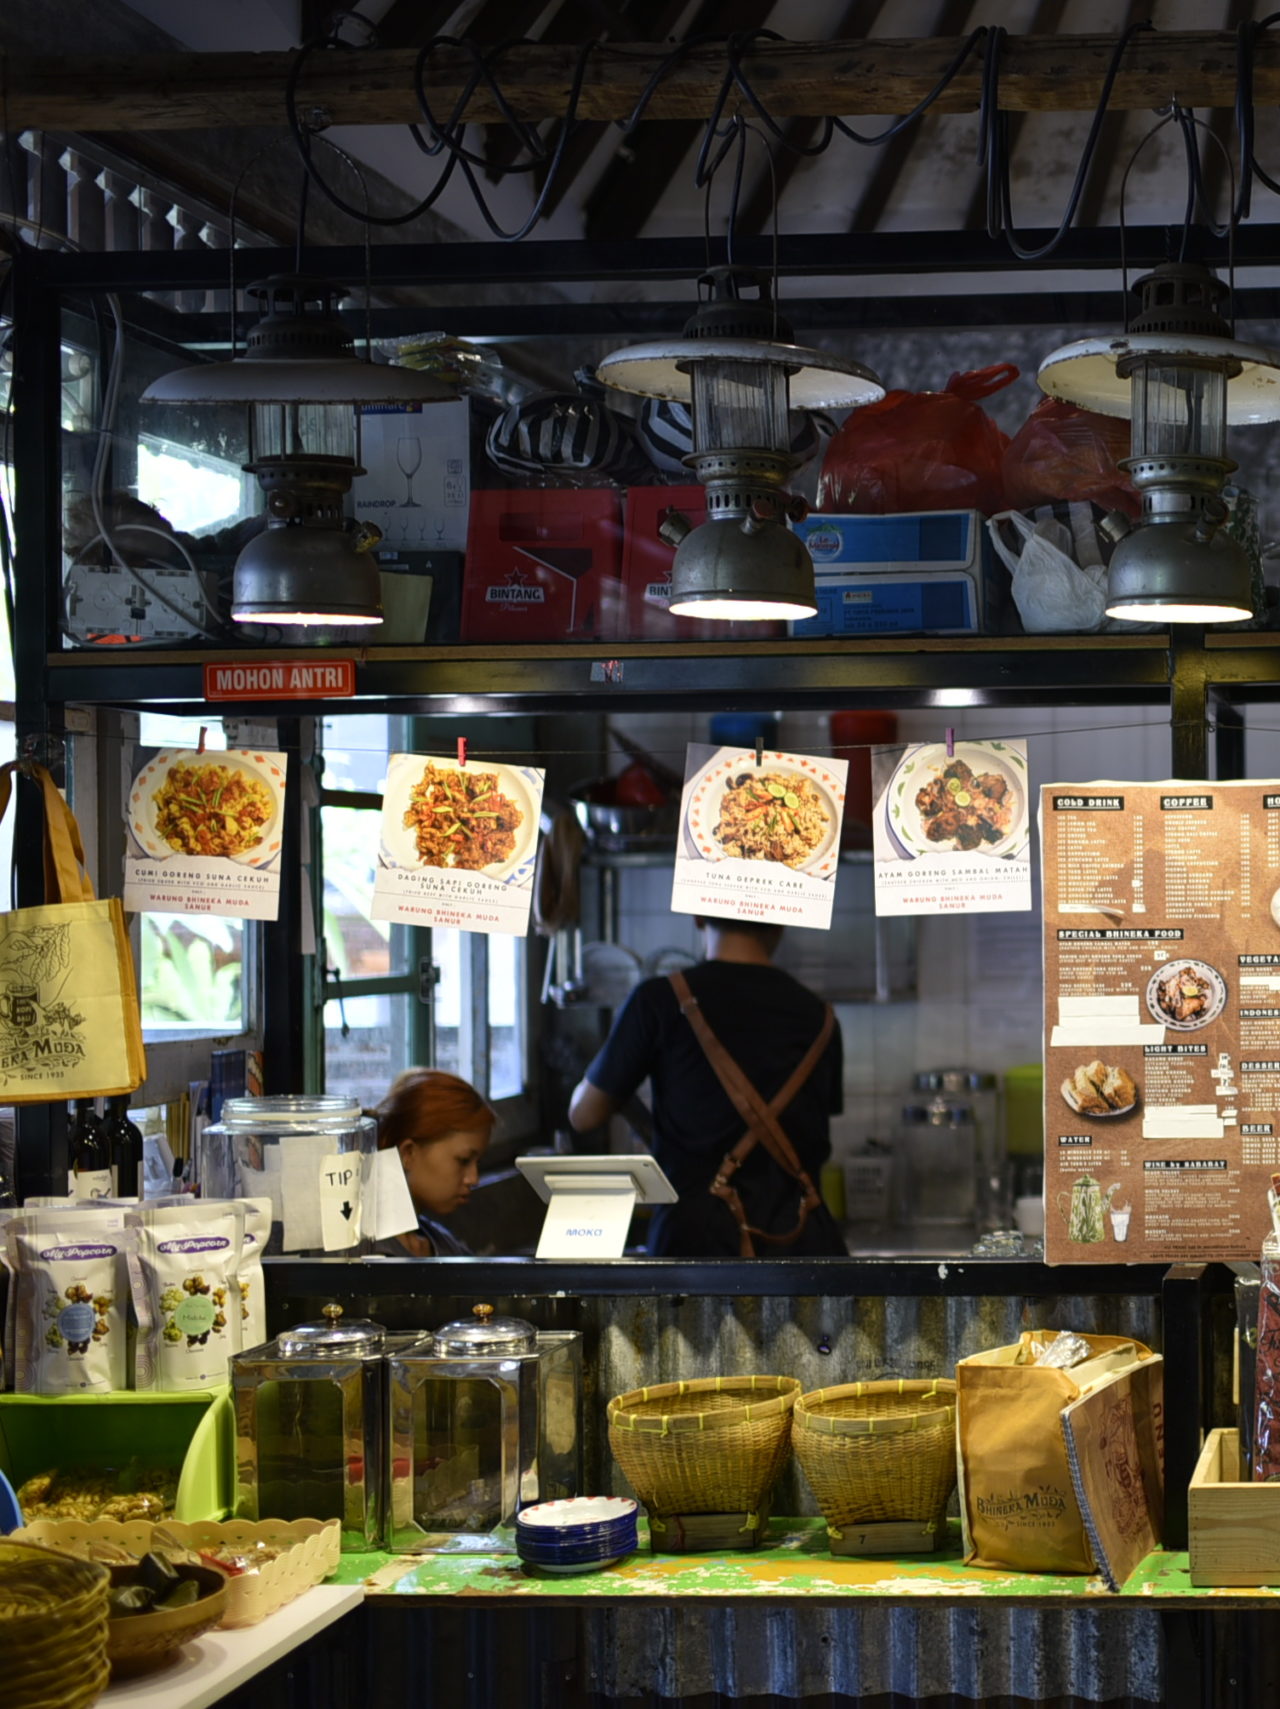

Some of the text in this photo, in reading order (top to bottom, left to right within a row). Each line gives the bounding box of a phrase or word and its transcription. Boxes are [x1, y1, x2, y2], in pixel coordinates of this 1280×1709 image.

[490, 588, 540, 600] BINTANG
[216, 666, 343, 691] MOHON ANTRI
[1057, 798, 1120, 806] COLD DRINK
[1163, 798, 1207, 806] COFFEE
[135, 869, 269, 883] CUMI GORENG SUNA CEKUH
[878, 866, 1028, 879] AYAM GORENG SAMBAL MATAH
[397, 873, 508, 892] DAGING SAPI GORENG
[706, 872, 804, 889] TUNA GEPREK CABE
[420, 883, 483, 895] SUNA CEKUH
[150, 894, 250, 906] WARUNG BHINEKA MUDA
[700, 896, 804, 914] WARUNG BHINEKA MUDA
[184, 903, 212, 911] SANUR
[397, 905, 500, 922] WARUNG BHINEKA MUDA
[433, 916, 461, 925] SANUR
[1059, 930, 1102, 938] SPECIAL
[1106, 930, 1150, 938] BHINEKA
[32, 1037, 86, 1058] MUDA
[1145, 1045, 1173, 1053] LIGHT
[20, 1072, 43, 1081] SINCE
[1241, 1125, 1271, 1134] BEER
[1059, 1136, 1091, 1144] WATER
[1024, 1492, 1066, 1510] MUDA
